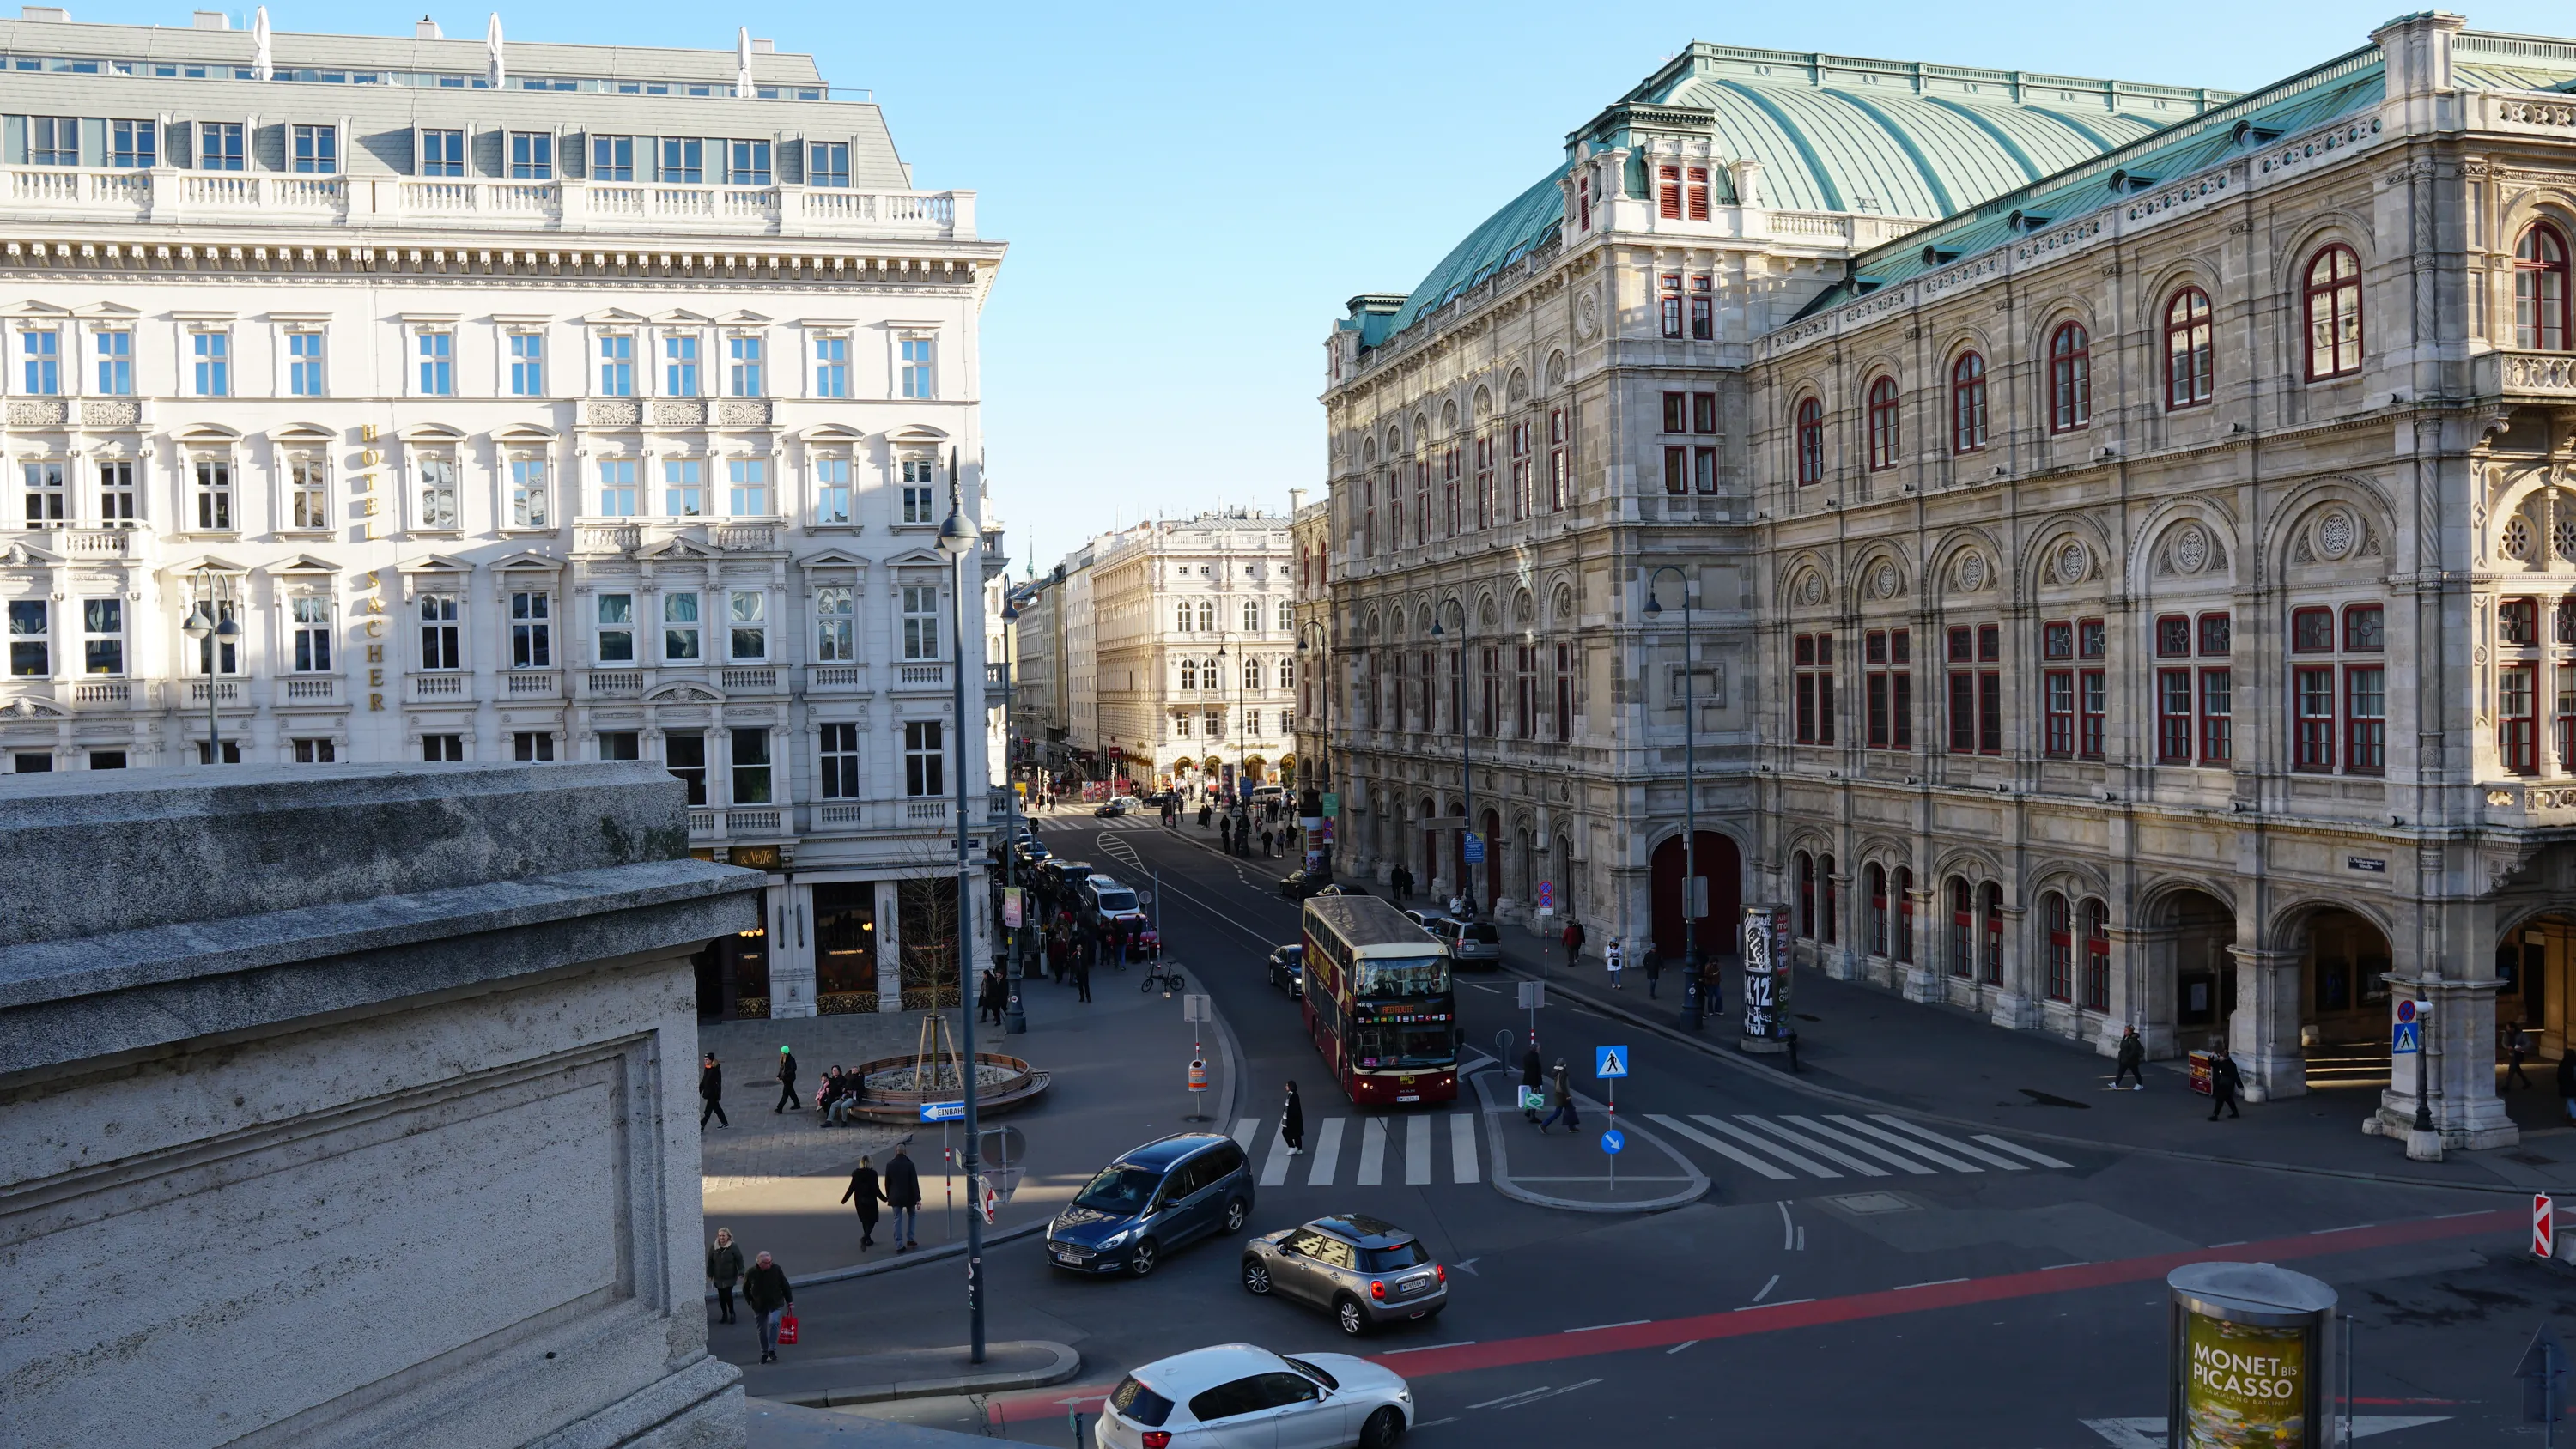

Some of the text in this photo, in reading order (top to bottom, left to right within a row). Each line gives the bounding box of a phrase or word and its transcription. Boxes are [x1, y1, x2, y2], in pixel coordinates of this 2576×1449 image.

[361, 424, 380, 541] HOTEL
[367, 570, 385, 712] SACHER
[740, 849, 772, 864] & Neffe
[1395, 1004, 1414, 1013] ROUTE
[2194, 1342, 2297, 1377] MONET BIS
[2194, 1361, 2293, 1399] PICASSO
[2204, 1387, 2249, 1404] SAMMLUNG
